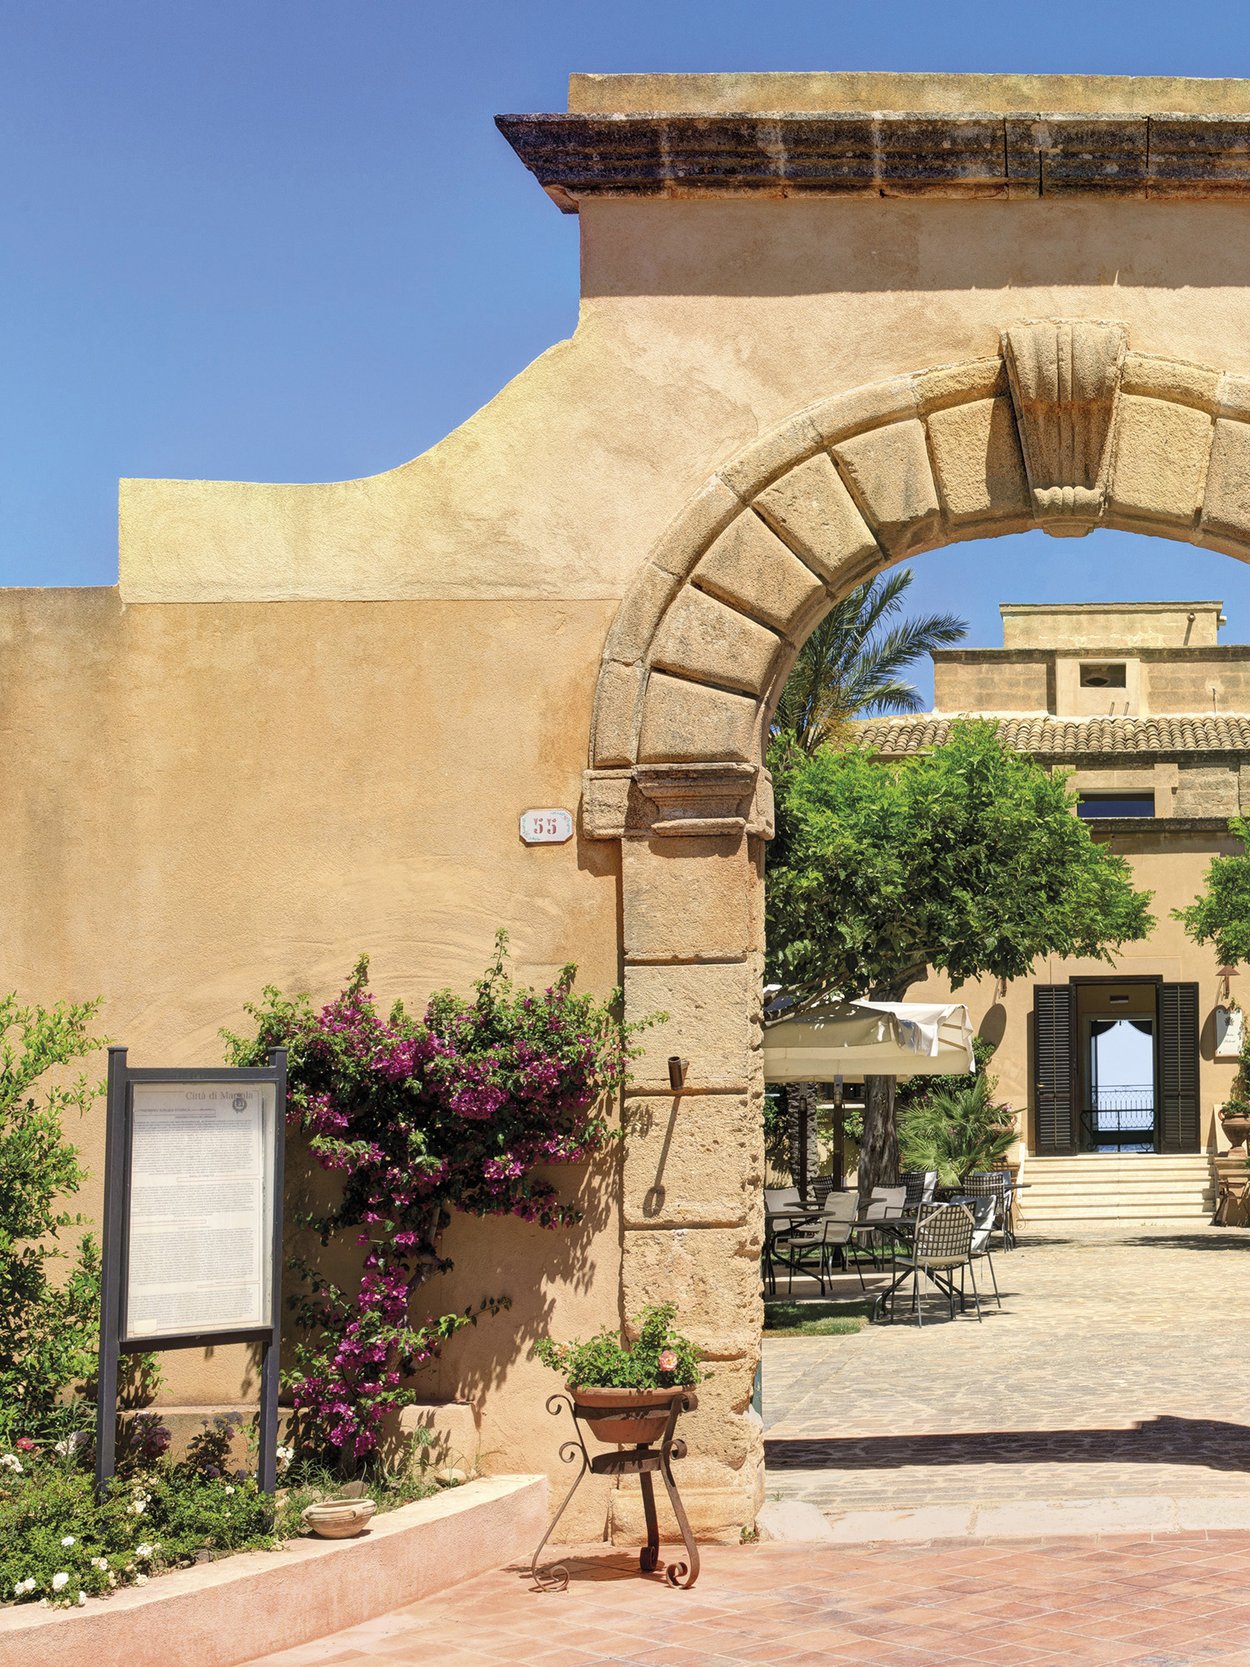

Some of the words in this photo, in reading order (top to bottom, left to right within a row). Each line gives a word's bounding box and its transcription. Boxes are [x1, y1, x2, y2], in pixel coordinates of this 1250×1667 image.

[533, 818, 557, 835] 55
[208, 1091, 218, 1100] di
[220, 1091, 254, 1100] Marla
